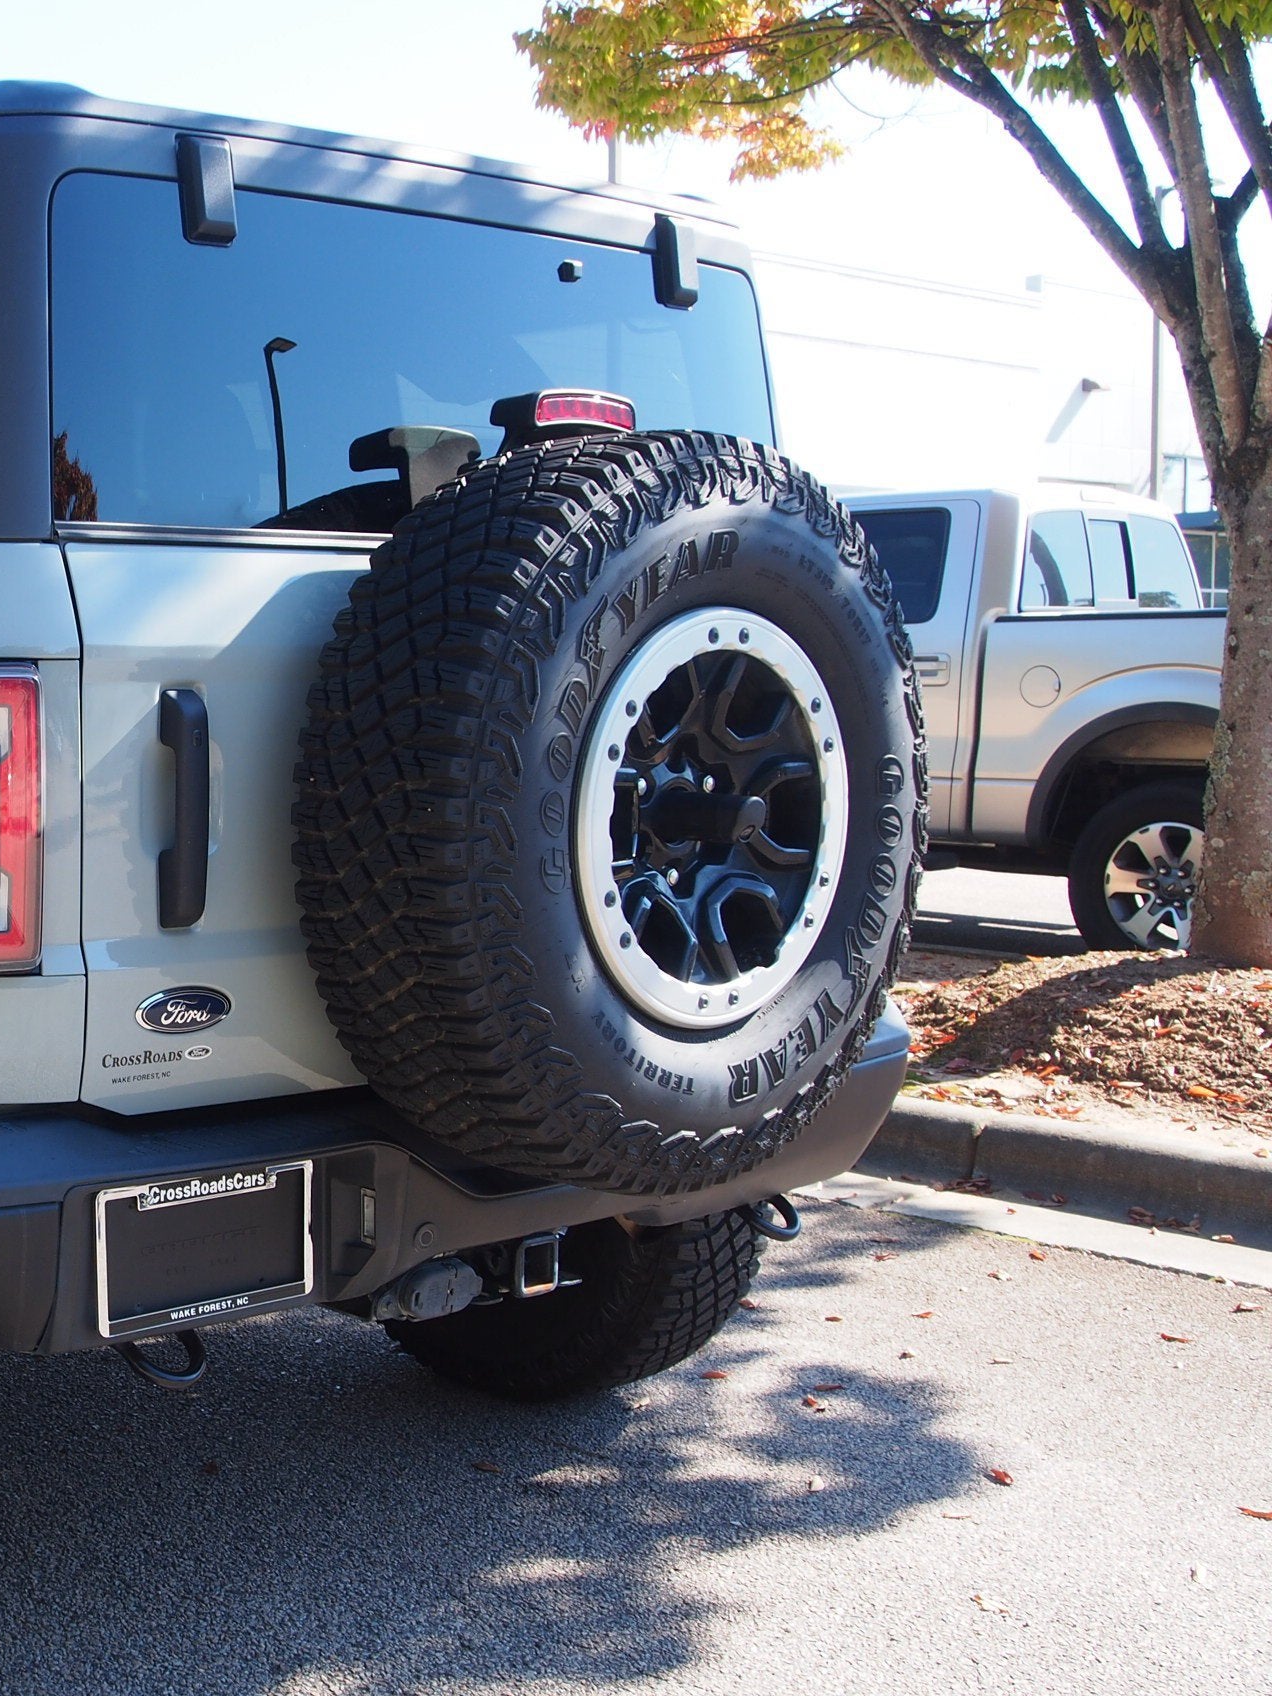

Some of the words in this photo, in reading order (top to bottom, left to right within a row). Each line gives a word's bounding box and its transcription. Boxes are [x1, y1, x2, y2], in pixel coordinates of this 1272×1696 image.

[161, 999, 210, 1025] Ford
[591, 1010, 695, 1096] TERRITORY
[111, 1075, 130, 1085] WAKE
[132, 1072, 161, 1082] FOREST,
[161, 1070, 172, 1079] NC
[148, 1172, 265, 1205] CrossRoadsCars
[170, 1308, 197, 1320] WAKE
[198, 1300, 235, 1314] FOREST,
[236, 1296, 249, 1306] NC
